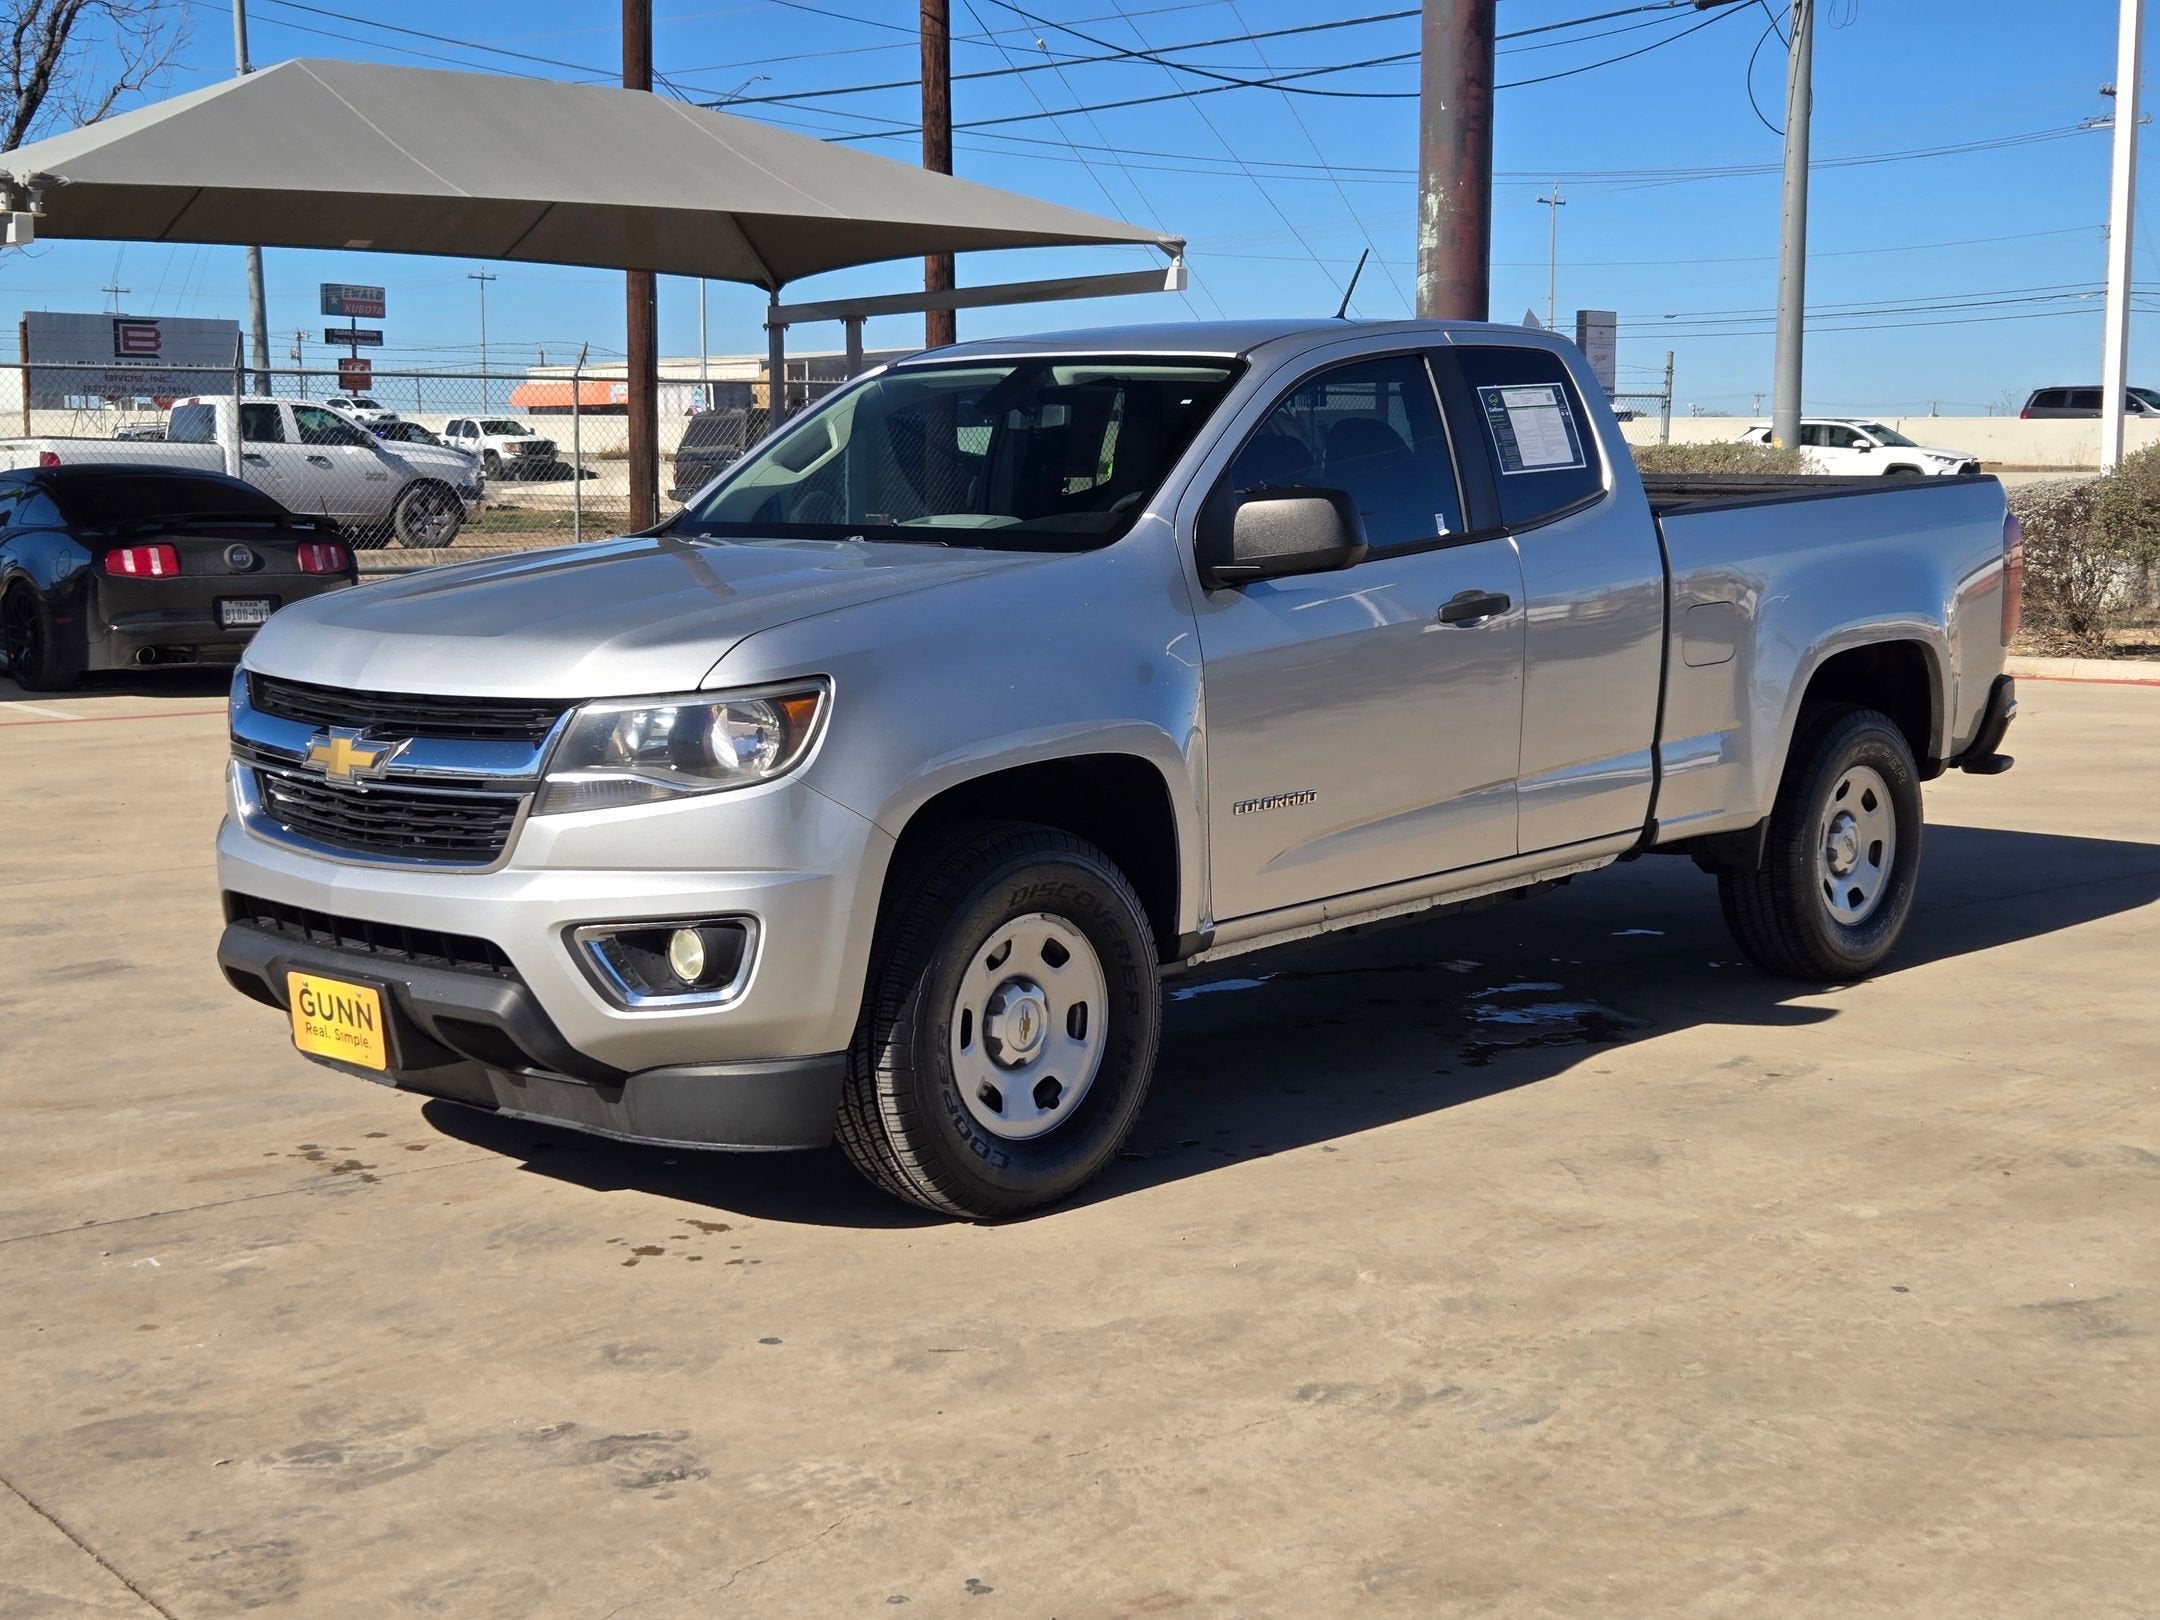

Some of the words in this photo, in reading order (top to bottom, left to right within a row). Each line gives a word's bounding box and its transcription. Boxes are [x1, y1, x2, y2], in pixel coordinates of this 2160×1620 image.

[342, 287, 384, 300] EWALD
[344, 303, 384, 315] KUBOTA
[1233, 788, 1318, 816] COLORADO
[1008, 879, 1141, 1016] DISCOVERER
[299, 988, 374, 1032] GUNN
[305, 1021, 331, 1039] Real.
[334, 1028, 372, 1049] Simple.
[936, 1022, 1011, 1171] COOPER
